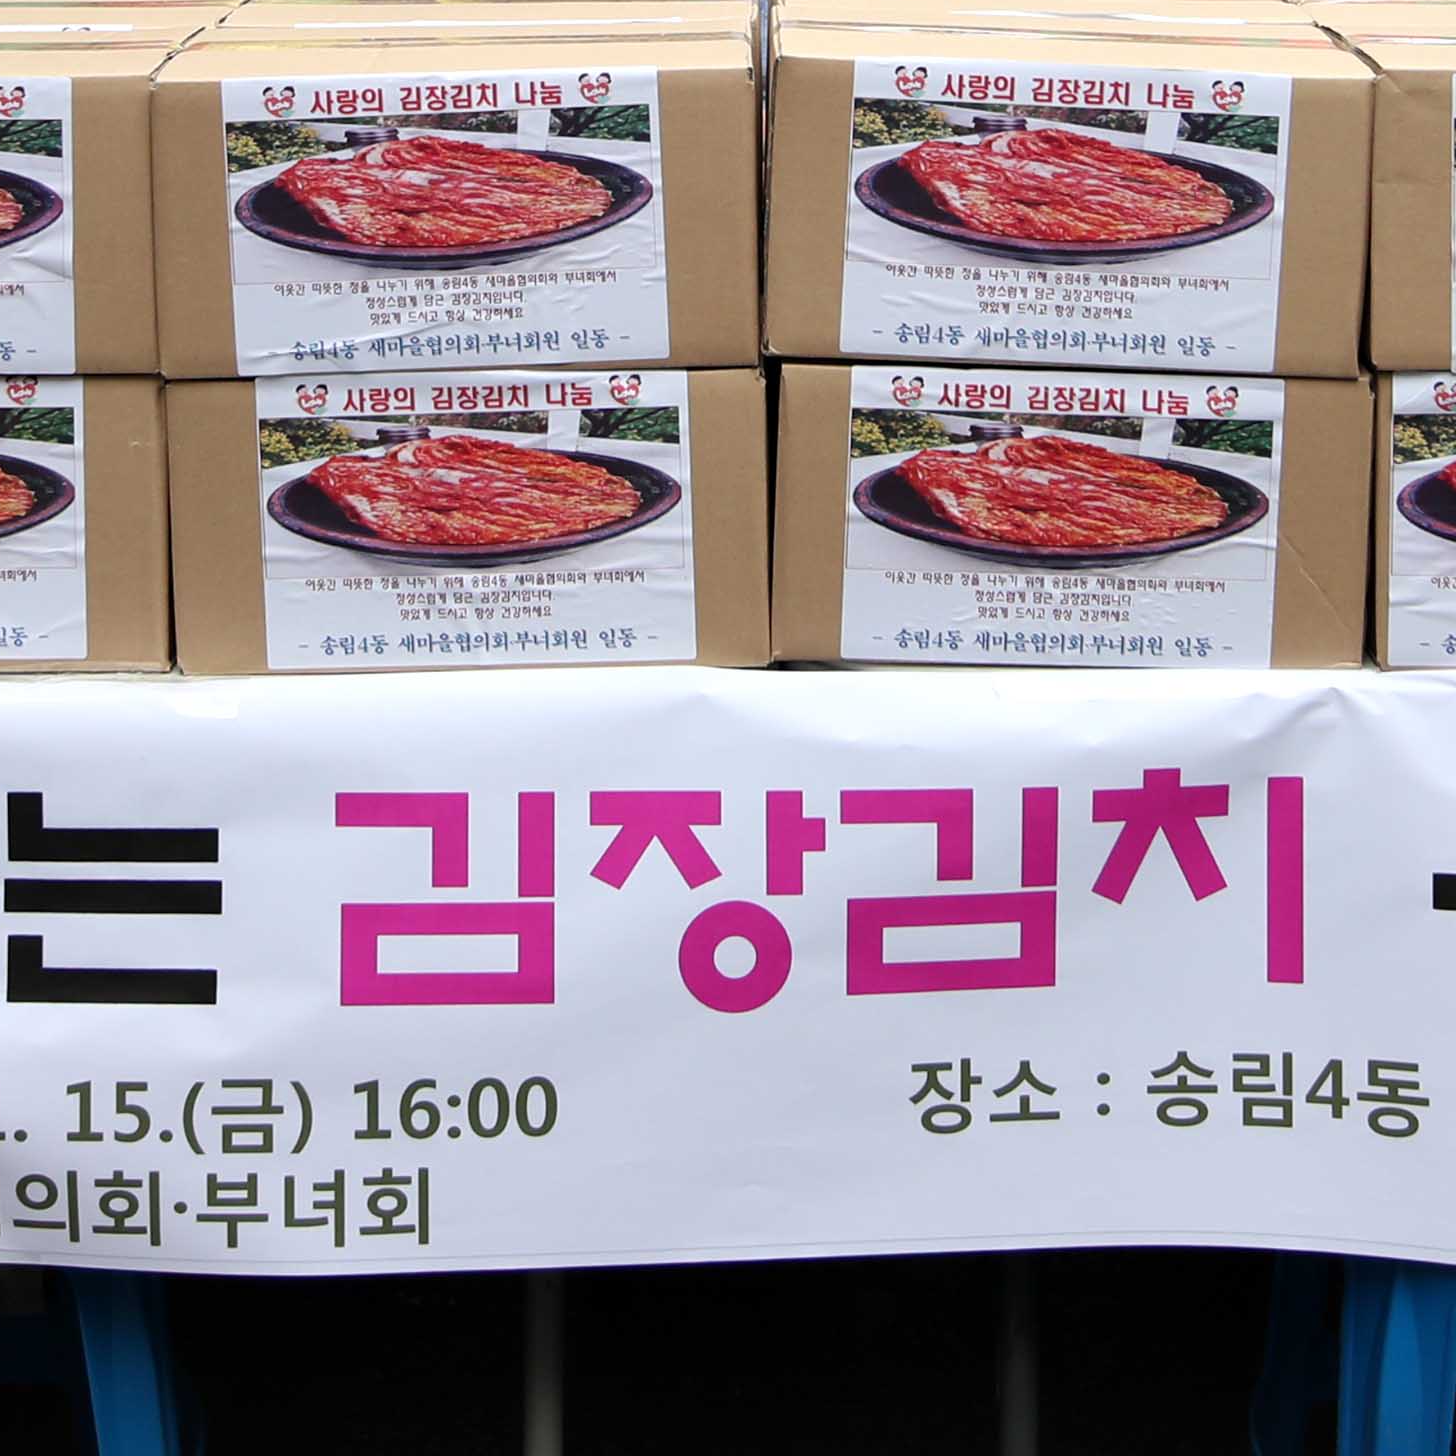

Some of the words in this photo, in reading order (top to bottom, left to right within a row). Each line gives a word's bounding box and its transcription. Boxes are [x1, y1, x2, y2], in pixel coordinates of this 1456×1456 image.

[310, 87, 383, 115] 사랑의
[400, 82, 499, 112] 김장김치
[515, 80, 562, 107] 나눔
[941, 72, 1015, 101] 사랑의
[1031, 77, 1132, 107] 김장김치
[1146, 82, 1195, 110] 나눔
[289, 340, 359, 363] 송림4동
[571, 329, 610, 352] 일동
[894, 323, 965, 347] 송림4동
[1177, 336, 1216, 359] 일동
[343, 386, 415, 413] 사랑의
[432, 383, 529, 411] 김장김치
[546, 381, 592, 408] 나눔
[938, 382, 1011, 409] 사랑의
[1027, 385, 1127, 413] 김장김치
[1142, 389, 1189, 415] 나눔
[320, 635, 388, 657] 송림4동
[599, 629, 637, 650] 일동
[894, 629, 964, 652] 송림4동
[1174, 638, 1213, 659] 일동
[335, 767, 1304, 1013] 김장김치
[909, 1058, 1060, 1134] 장소
[1147, 1051, 1429, 1137] 송림4동
[67, 1079, 312, 1154] 15.(금)
[354, 1077, 557, 1139] 16:00
